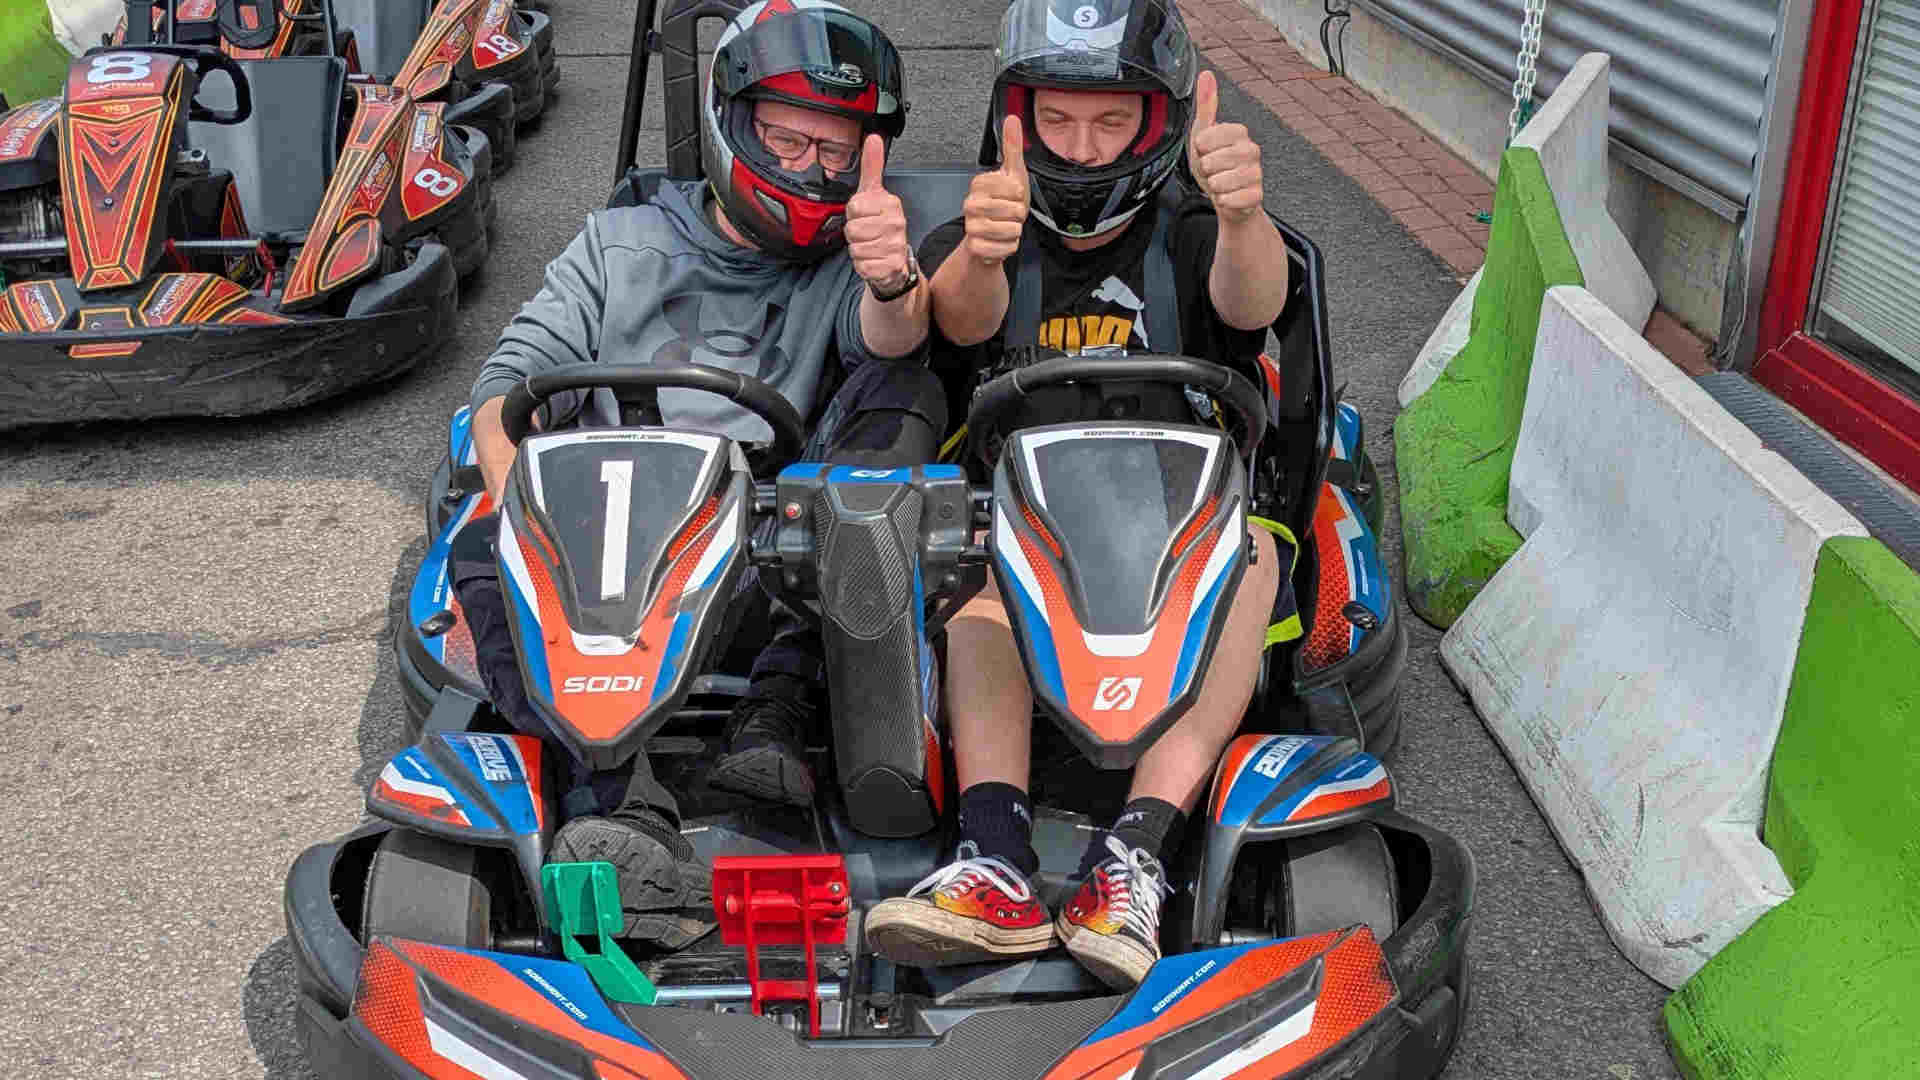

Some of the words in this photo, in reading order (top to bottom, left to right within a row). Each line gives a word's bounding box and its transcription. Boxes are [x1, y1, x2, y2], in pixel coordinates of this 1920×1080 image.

[477, 34, 520, 60] 18
[87, 52, 152, 83] 8
[413, 168, 458, 197] 8
[600, 460, 633, 600] 1
[562, 675, 645, 693] SODI
